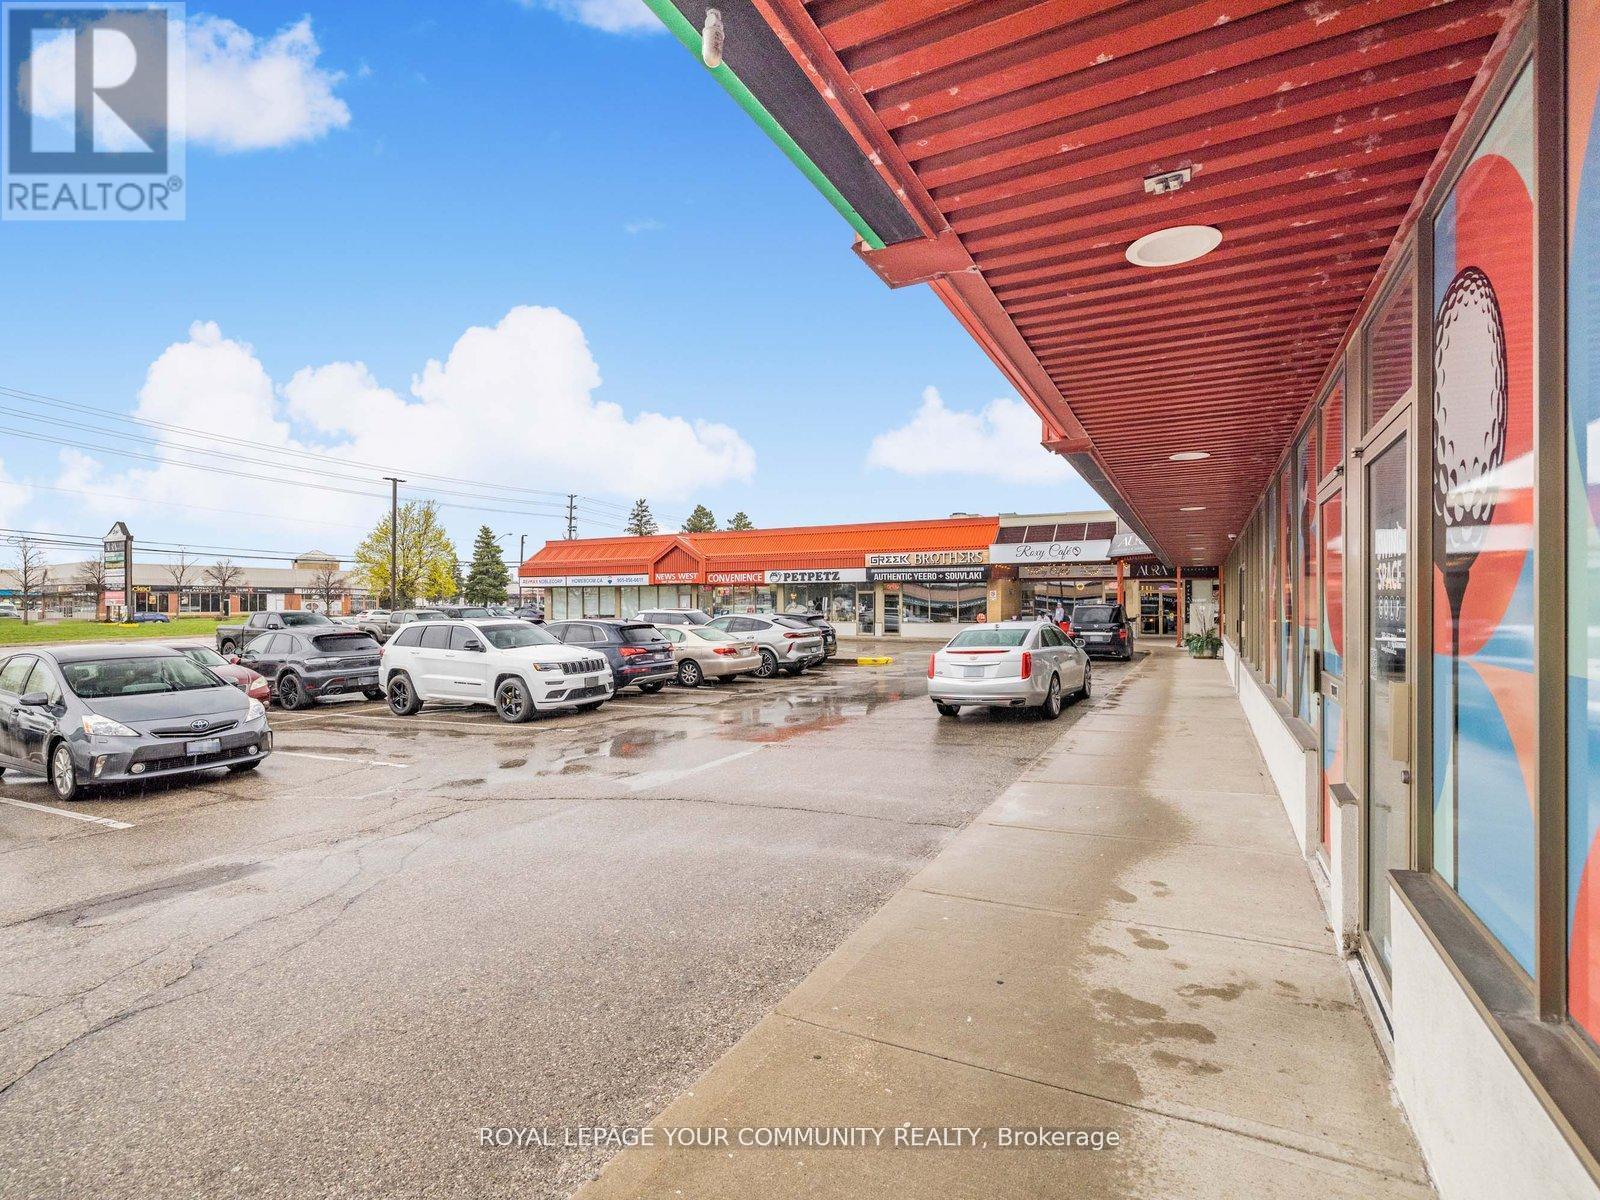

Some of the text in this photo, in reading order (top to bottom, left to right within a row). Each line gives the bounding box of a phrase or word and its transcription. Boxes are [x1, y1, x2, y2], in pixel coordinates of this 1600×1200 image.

[1016, 543, 1073, 560] Roxy Café
[656, 572, 698, 580] NEWS WEST
[1136, 565, 1168, 576] AURA
[707, 572, 763, 583] CONVENIENCE
[783, 571, 840, 582] PETPETZ
[873, 572, 912, 581] AUTHENTIC
[913, 572, 937, 580] YEERO
[945, 572, 982, 580] SOUVLAKI
